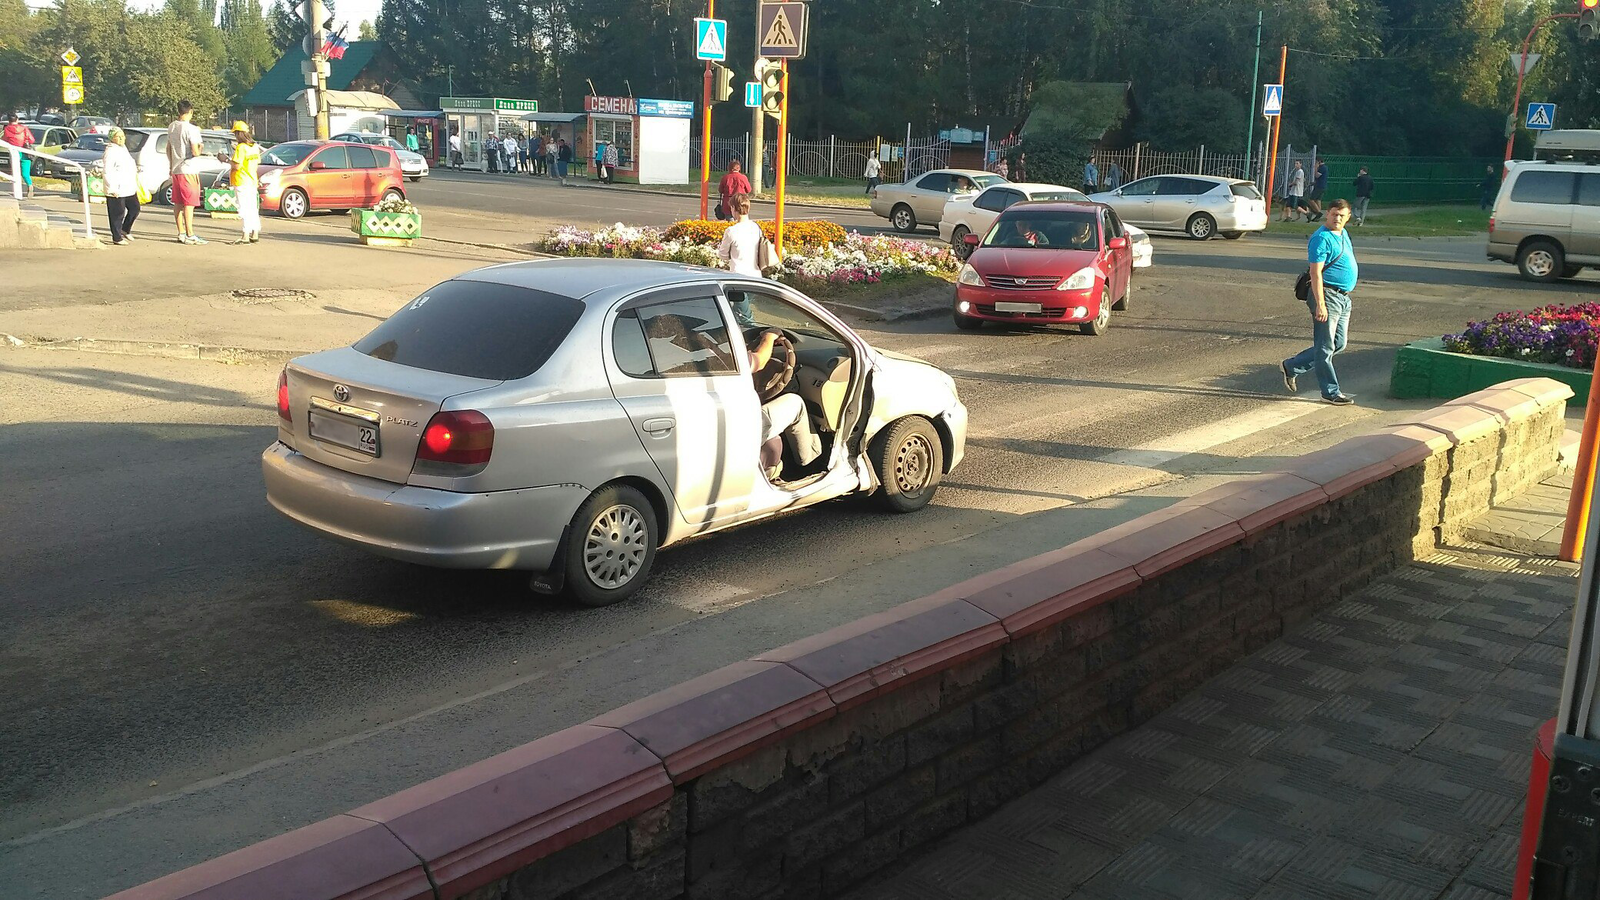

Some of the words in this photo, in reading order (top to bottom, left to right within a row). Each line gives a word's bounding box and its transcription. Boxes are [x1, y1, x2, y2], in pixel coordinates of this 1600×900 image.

[591, 97, 634, 112] СЕМЕНА
[386, 415, 418, 427] PLATZ
[360, 428, 371, 443] 22
[534, 581, 552, 590] TOYOTA
